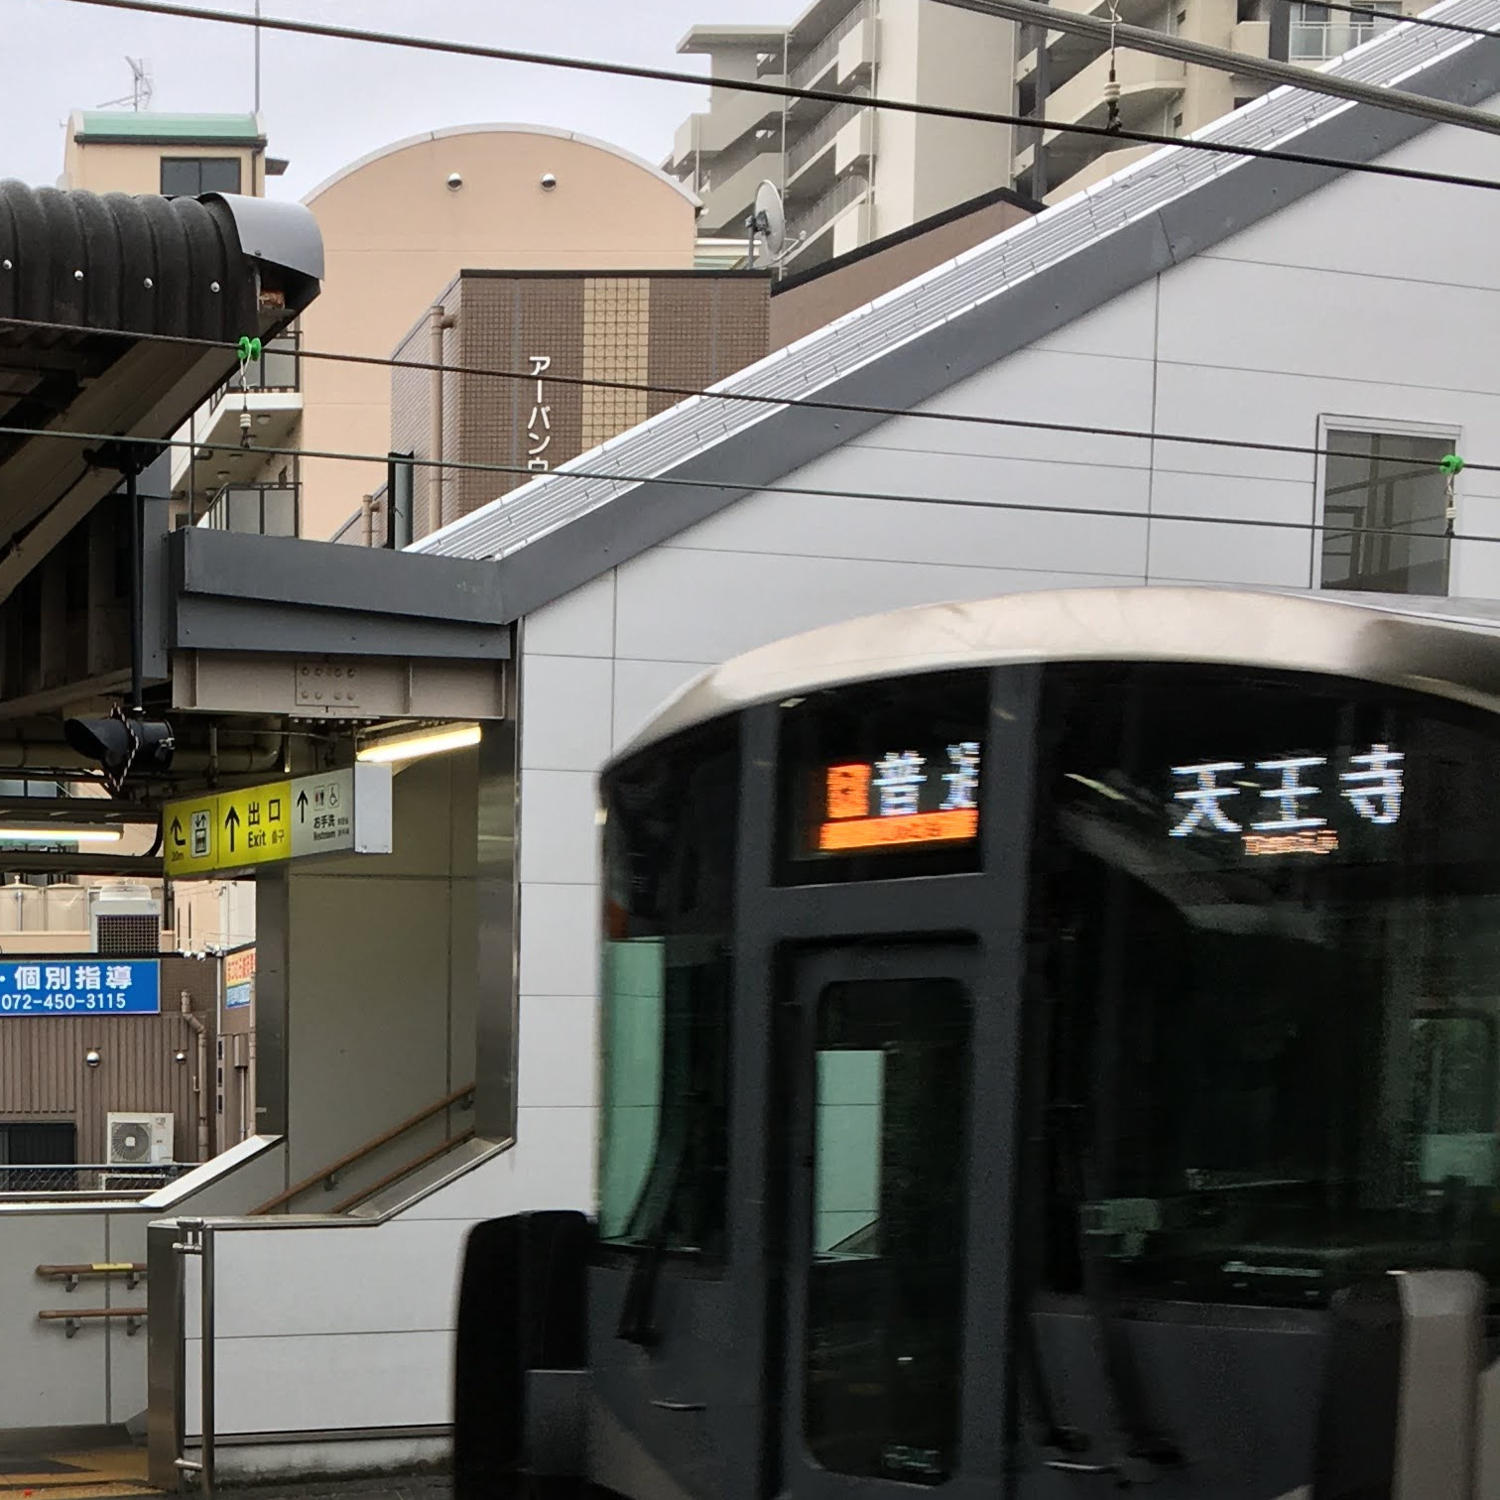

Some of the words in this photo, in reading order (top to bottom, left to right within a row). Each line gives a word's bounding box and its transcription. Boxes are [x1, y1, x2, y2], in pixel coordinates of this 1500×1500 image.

[1168, 744, 1405, 837] 天王寺
[248, 799, 281, 826] 出口
[248, 829, 267, 848] Exit
[2, 994, 127, 1010] 072-450-3115
